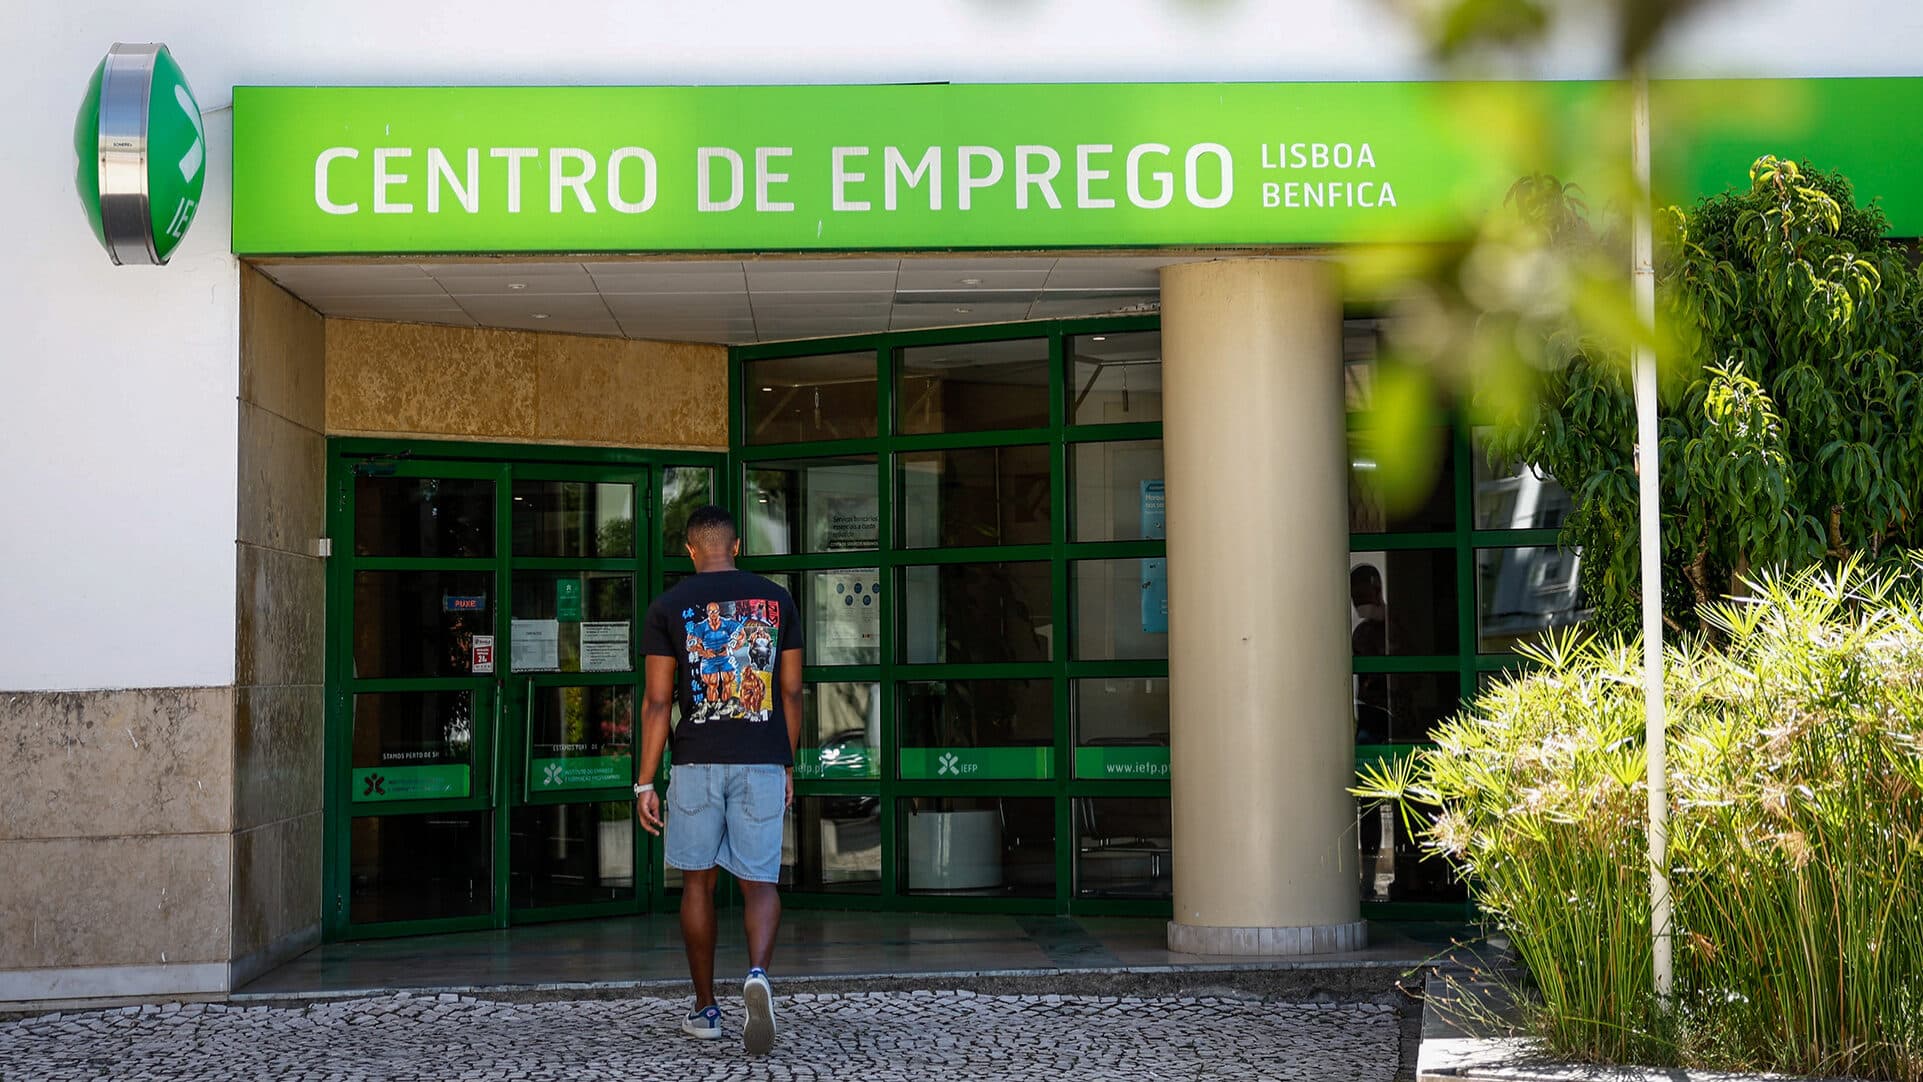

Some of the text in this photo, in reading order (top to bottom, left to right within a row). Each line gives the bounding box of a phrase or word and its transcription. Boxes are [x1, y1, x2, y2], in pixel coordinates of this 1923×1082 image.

[1261, 142, 1376, 169] LISBOA
[314, 142, 1234, 215] CENTRO DE EMPREGO
[1262, 181, 1397, 208] BENFICA
[166, 197, 197, 238] IE
[453, 599, 477, 608] PUXE
[382, 752, 404, 760] STAMOS
[961, 764, 978, 774] IEFP
[1106, 760, 1170, 776] www.iefp.p
